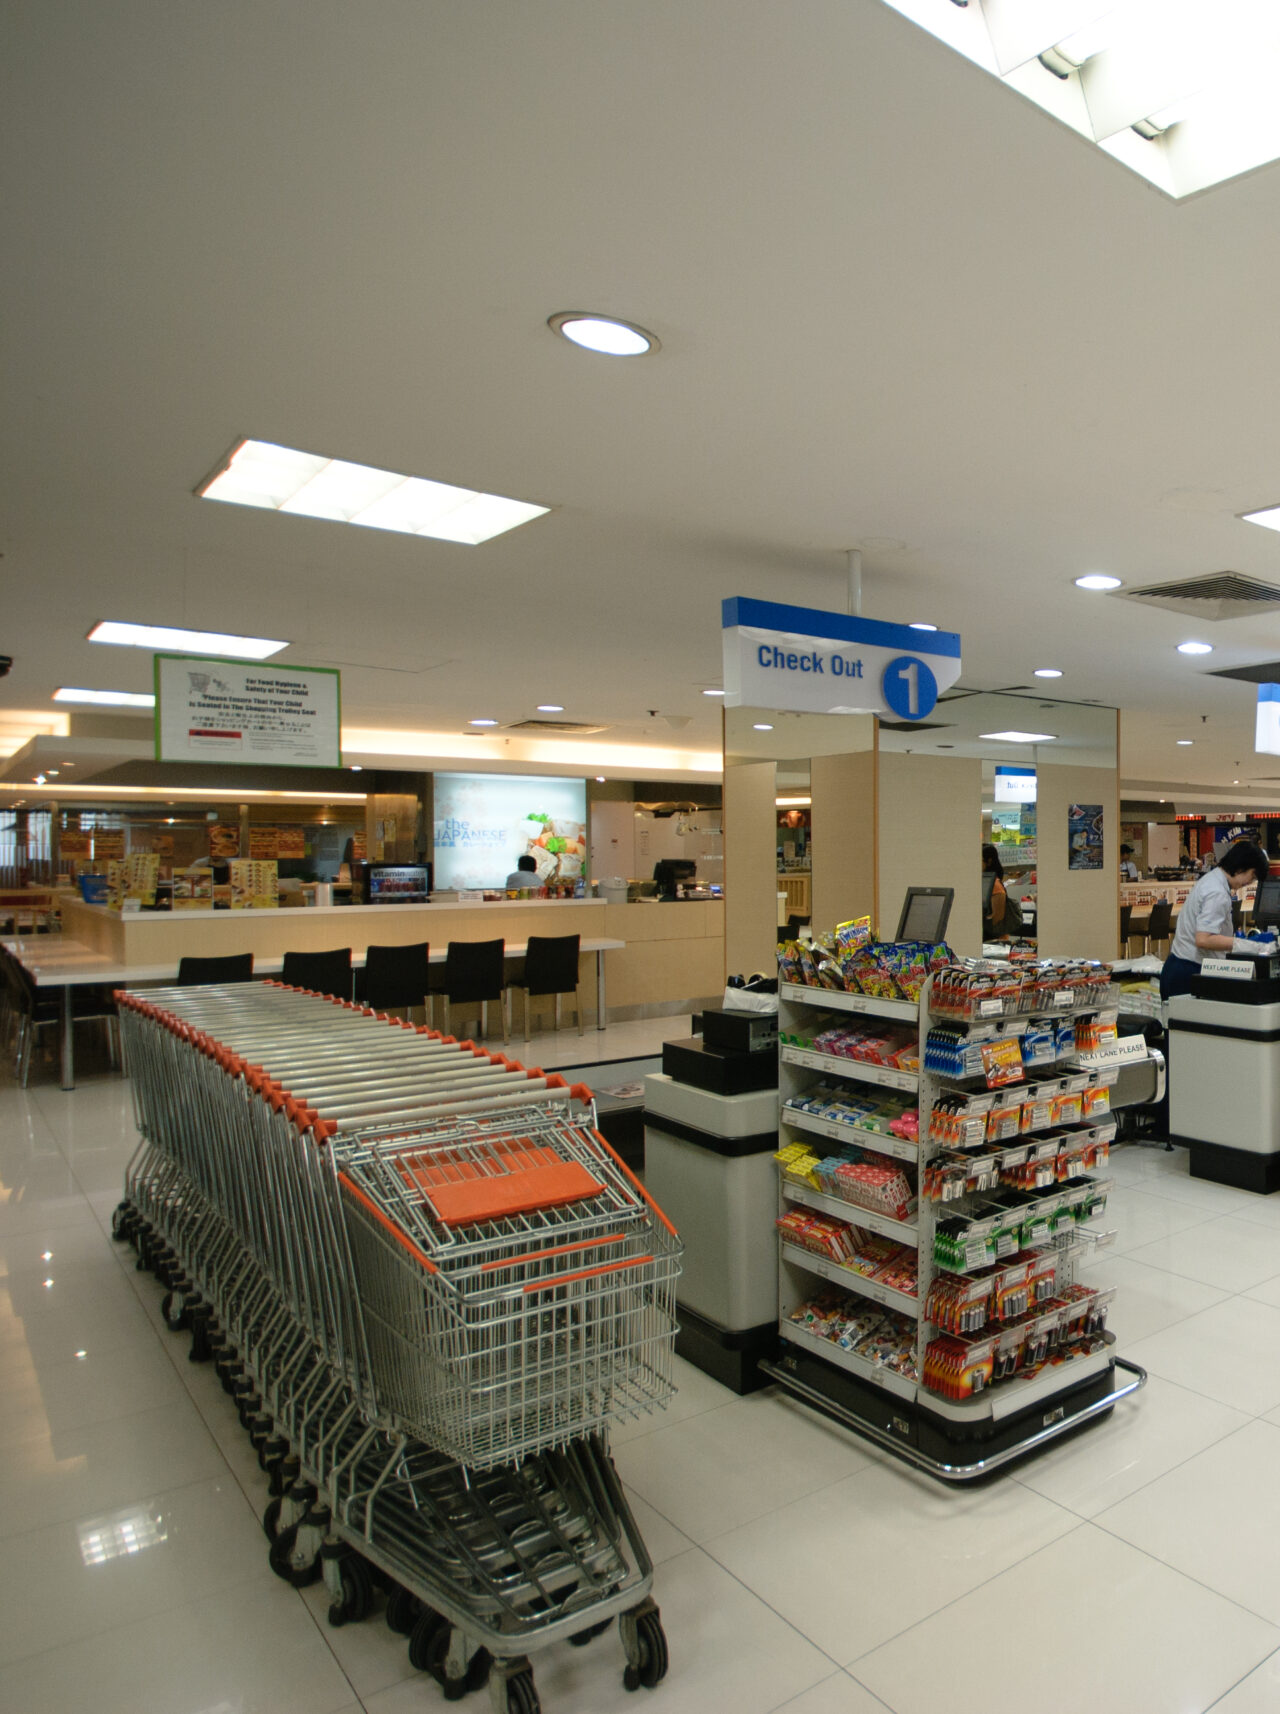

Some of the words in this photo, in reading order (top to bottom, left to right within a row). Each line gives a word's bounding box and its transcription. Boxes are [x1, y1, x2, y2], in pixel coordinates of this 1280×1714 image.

[757, 644, 825, 675] Check
[830, 653, 865, 680] Out
[897, 662, 921, 716] 1
[253, 697, 268, 705] That
[445, 818, 470, 830] the
[434, 829, 507, 841] JAPANESE
[1230, 966, 1251, 974] PLEASE
[1100, 1049, 1118, 1059] LANE
[1119, 1043, 1145, 1056] PLEASE
